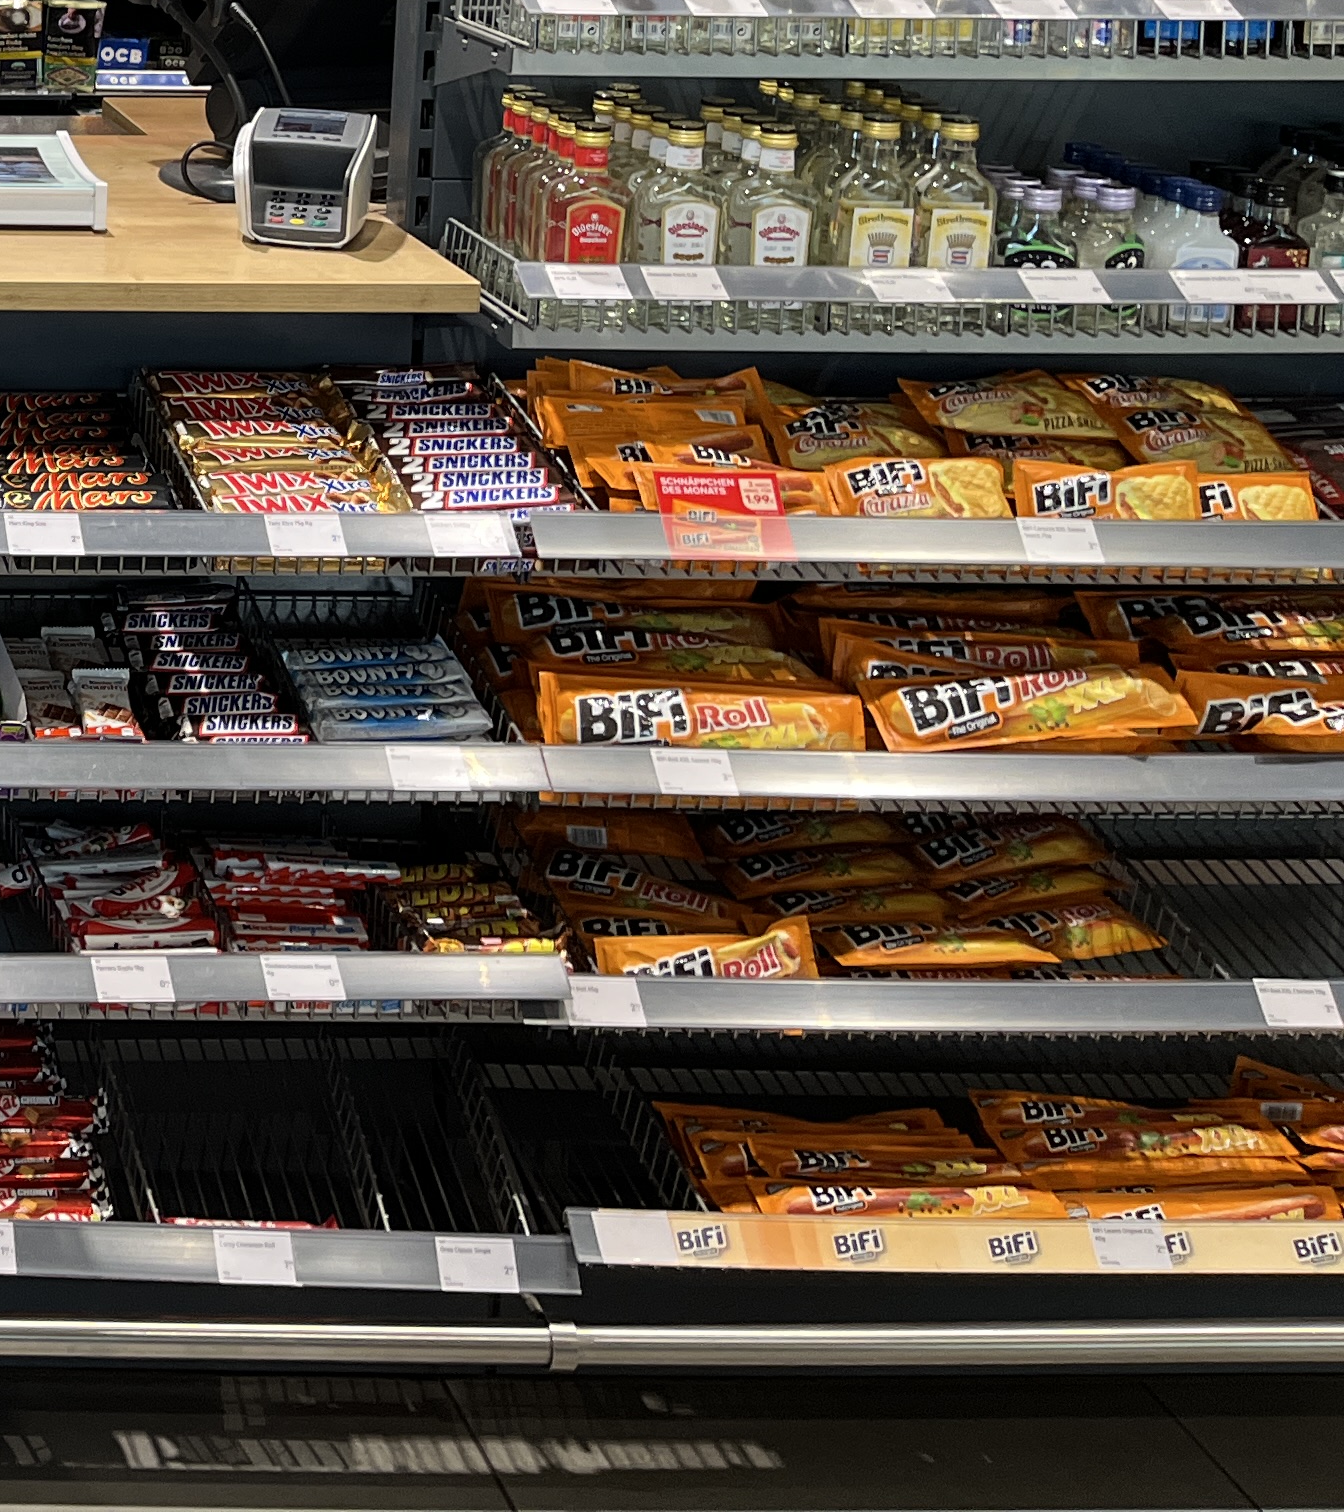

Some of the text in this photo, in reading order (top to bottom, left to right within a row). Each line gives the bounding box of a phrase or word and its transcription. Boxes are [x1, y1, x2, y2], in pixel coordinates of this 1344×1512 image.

[419, 438, 515, 451] SNICKERS
[442, 470, 541, 487] SNICKERS
[683, 487, 726, 495] MONATS
[126, 613, 211, 630] SNICKERS
[204, 714, 296, 733] SNICKERS
[696, 698, 768, 732] Roll
